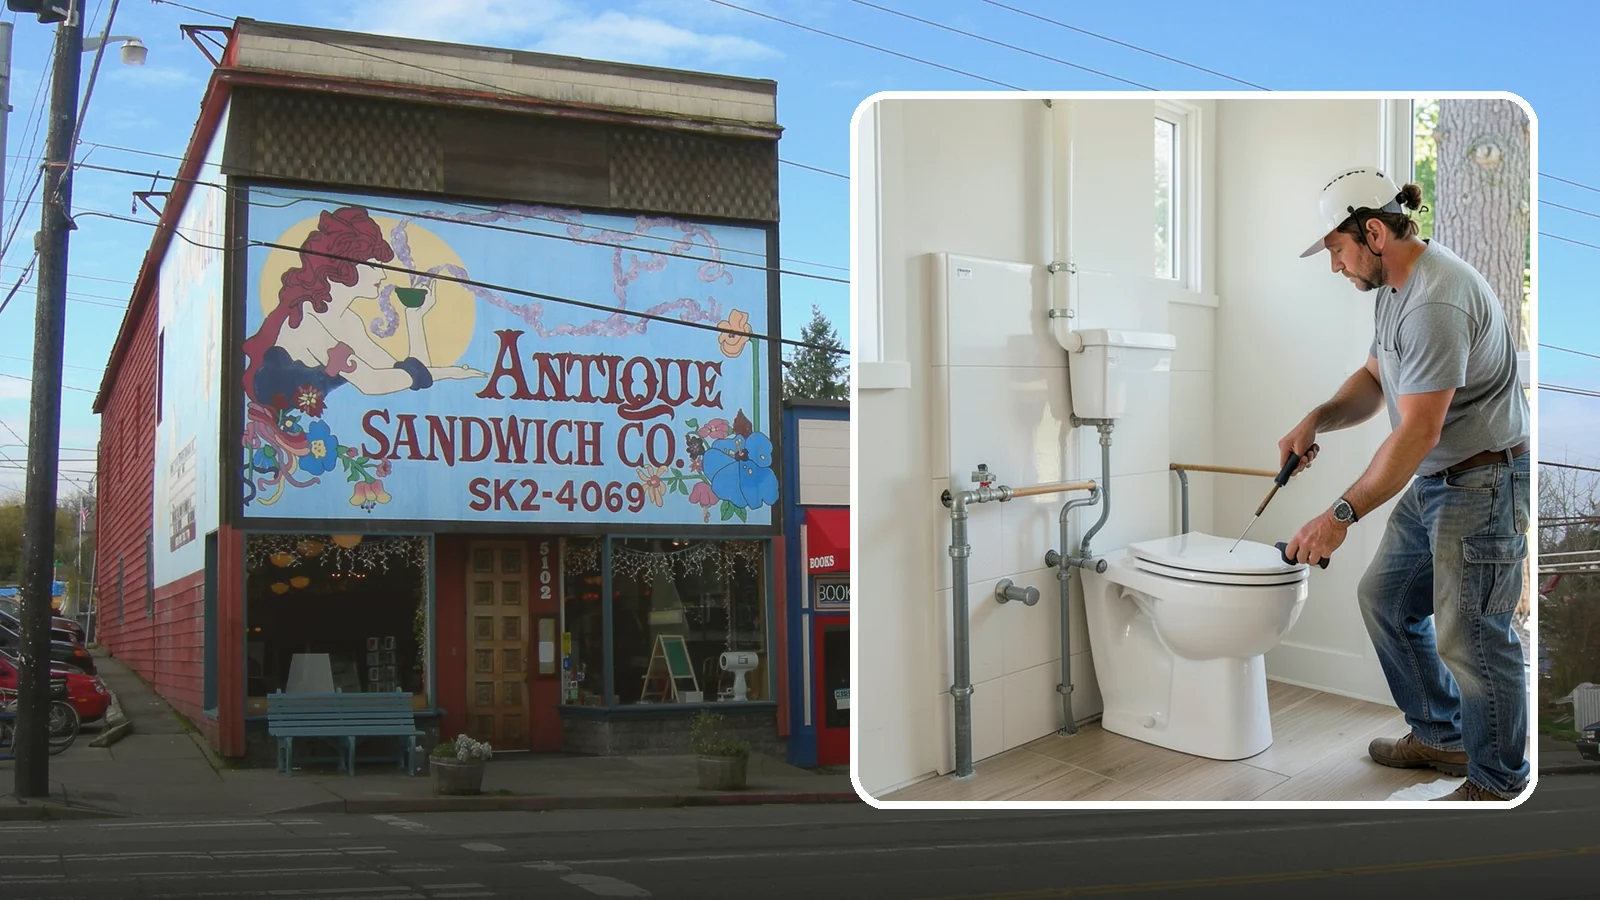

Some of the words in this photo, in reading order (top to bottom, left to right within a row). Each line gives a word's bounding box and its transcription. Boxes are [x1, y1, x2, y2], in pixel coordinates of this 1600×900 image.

[476, 329, 724, 421] ANTIQUE
[361, 408, 605, 467] SANDWICH
[617, 422, 685, 469] CO.
[468, 477, 646, 513] SK2-4069
[540, 541, 551, 600] 5102
[809, 555, 835, 569] BOOKS
